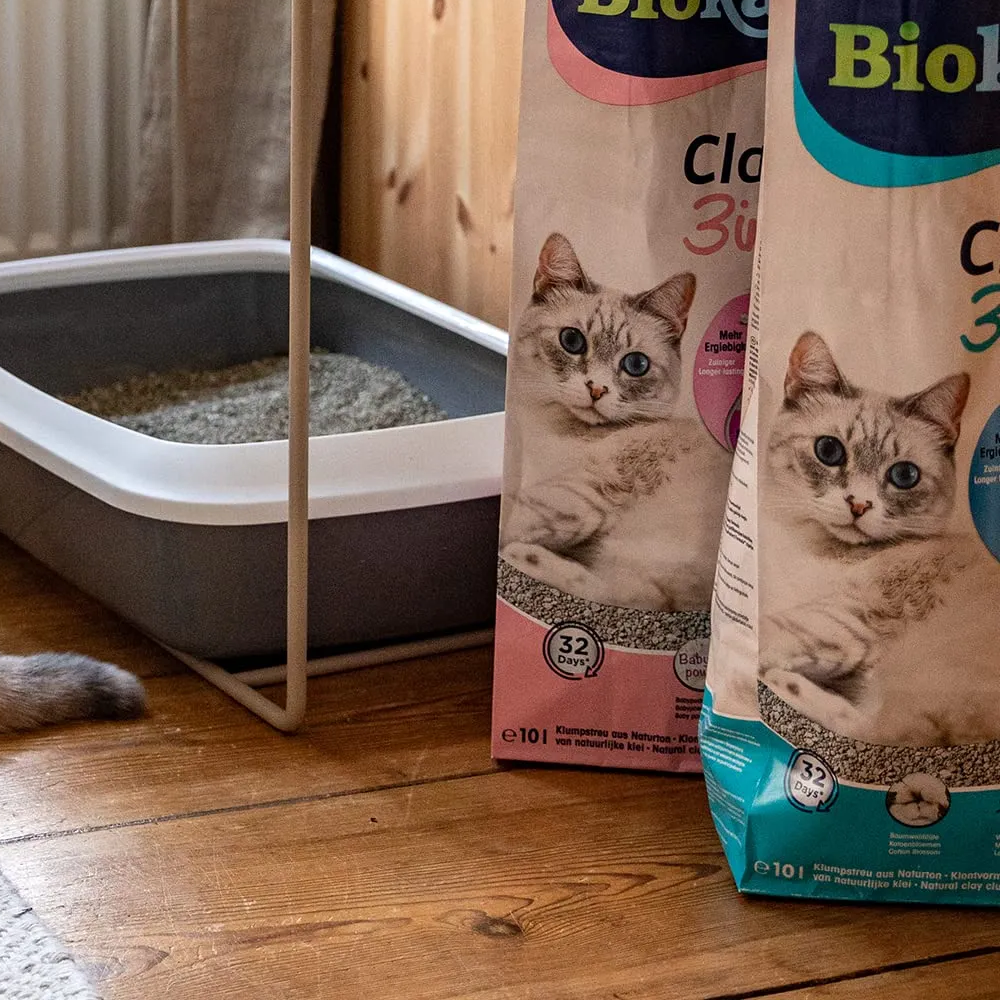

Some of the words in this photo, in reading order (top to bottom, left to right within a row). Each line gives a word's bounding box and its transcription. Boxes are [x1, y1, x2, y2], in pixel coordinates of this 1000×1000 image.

[719, 330, 743, 340] Mehr
[973, 475, 996, 486] Longer
[558, 635, 589, 656] 32
[555, 725, 609, 738] Klumpstreu
[612, 730, 628, 740] aus
[631, 731, 672, 743] Naturton
[555, 737, 572, 747] van
[574, 738, 625, 752] natuurlijke
[627, 741, 645, 752] klei
[652, 744, 686, 755] Natural
[801, 759, 826, 789] 32
[813, 863, 873, 878] Klumpstreu
[875, 870, 894, 879] aus
[897, 869, 942, 880] Naturton
[812, 873, 831, 882] van
[834, 875, 890, 890] natuurlijke
[892, 879, 912, 889] klei
[920, 880, 958, 891] Natural
[961, 880, 982, 892] clay
